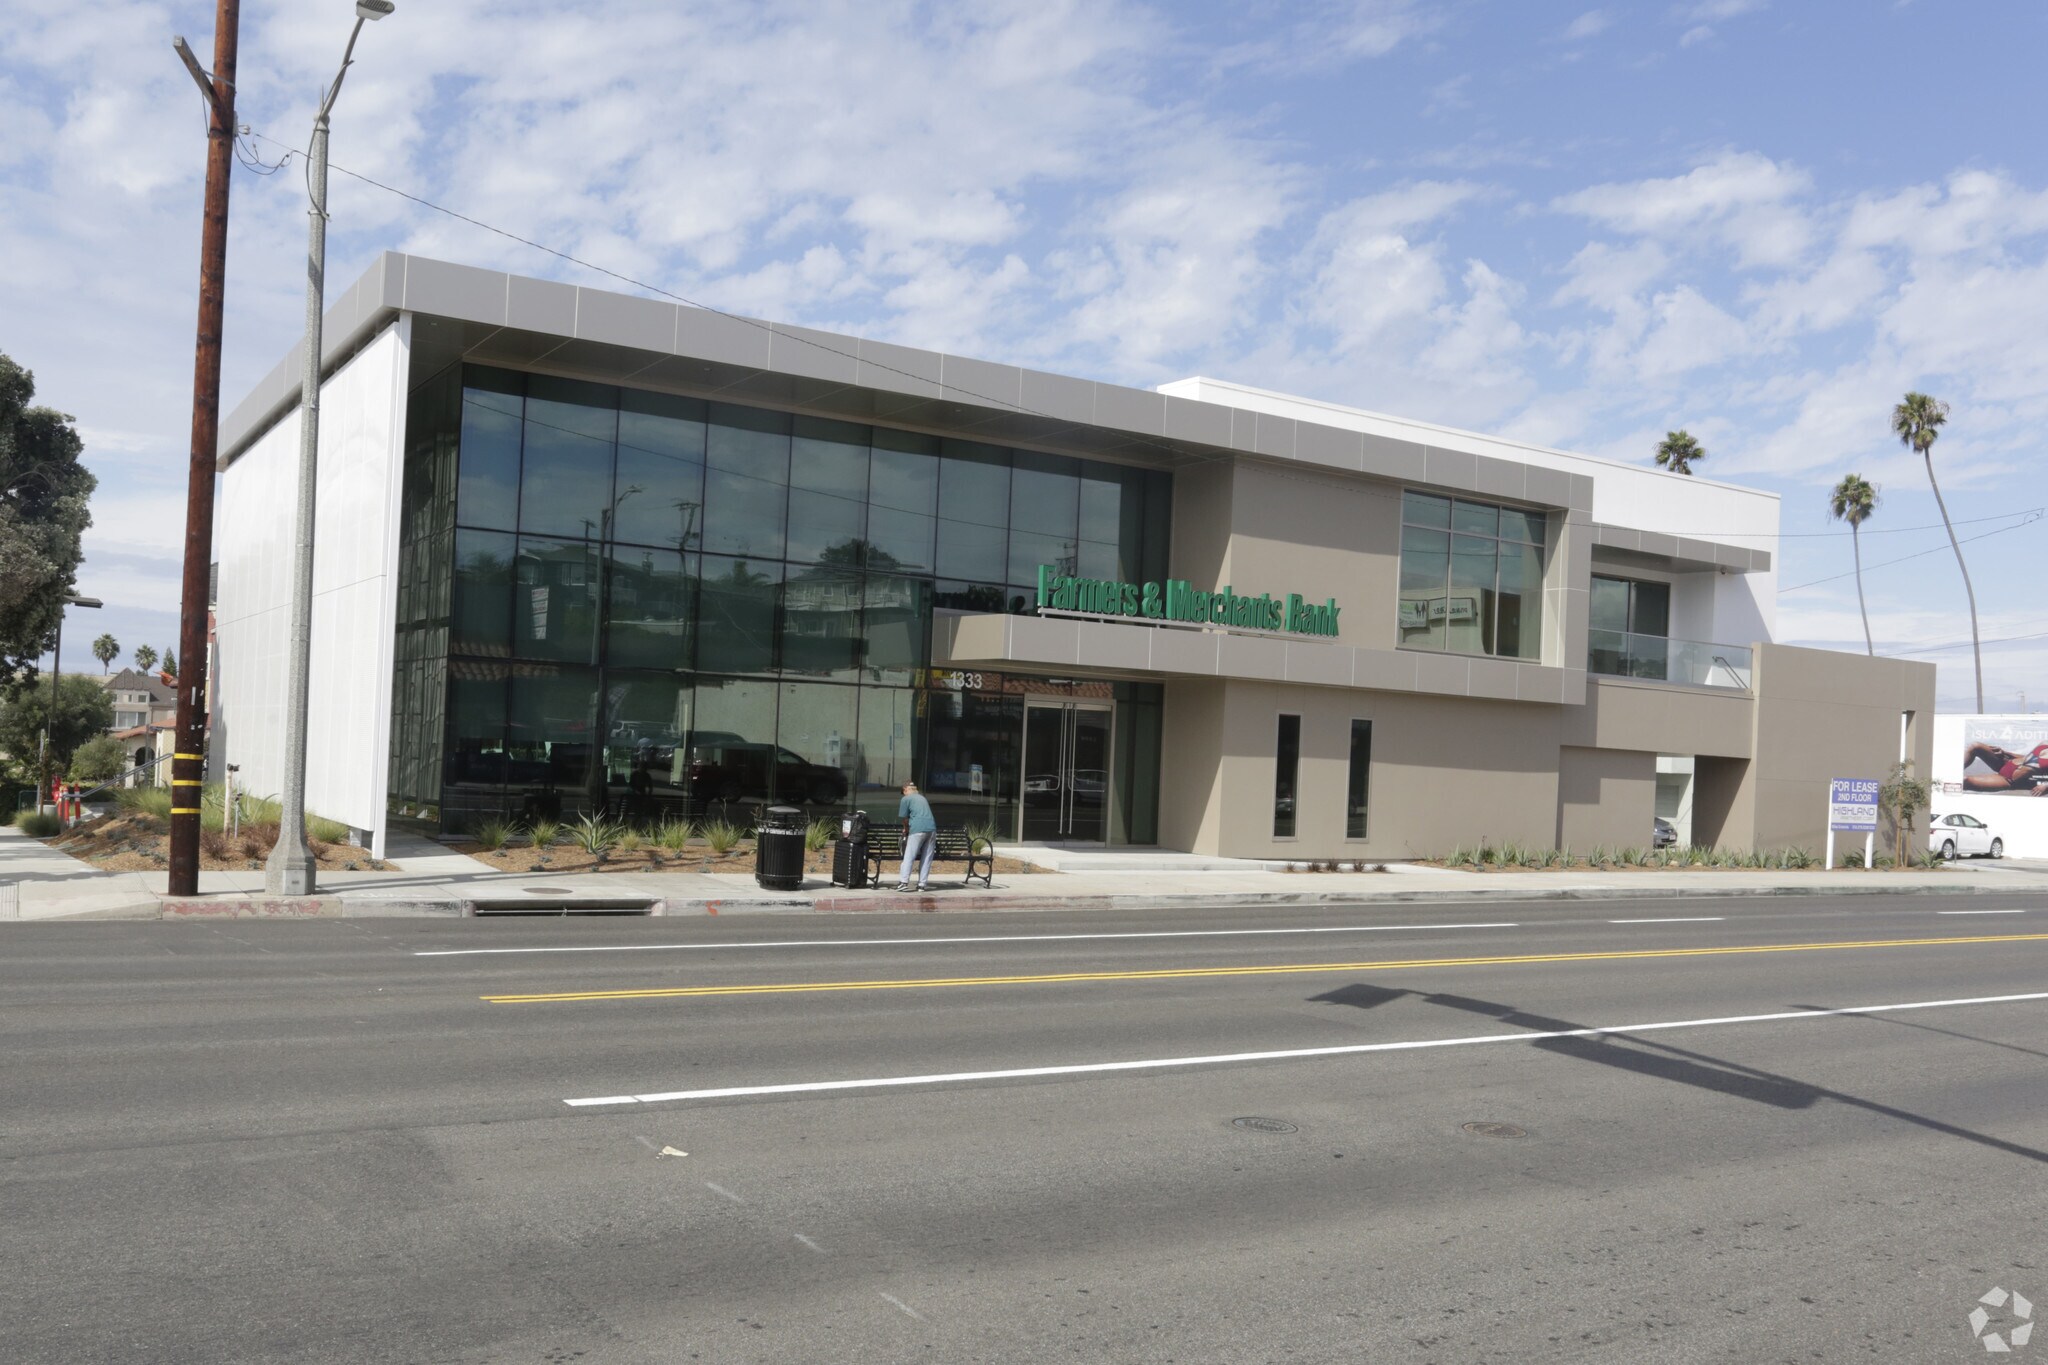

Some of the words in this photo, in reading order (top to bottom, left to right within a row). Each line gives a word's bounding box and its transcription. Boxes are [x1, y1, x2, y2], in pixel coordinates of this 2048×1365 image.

[1038, 564, 1139, 617] Farmers
[1142, 581, 1164, 619] &
[1166, 578, 1283, 631] Merchants
[1286, 593, 1341, 637] Bank
[950, 671, 982, 689] 1333
[1971, 729, 1997, 739] ISLA
[1833, 781, 1850, 792] FOR
[1851, 782, 1878, 793] LEASE
[1837, 793, 1850, 801] 2ND
[1851, 794, 1872, 802] FLOOR
[1833, 806, 1875, 816] HIGHLAND
